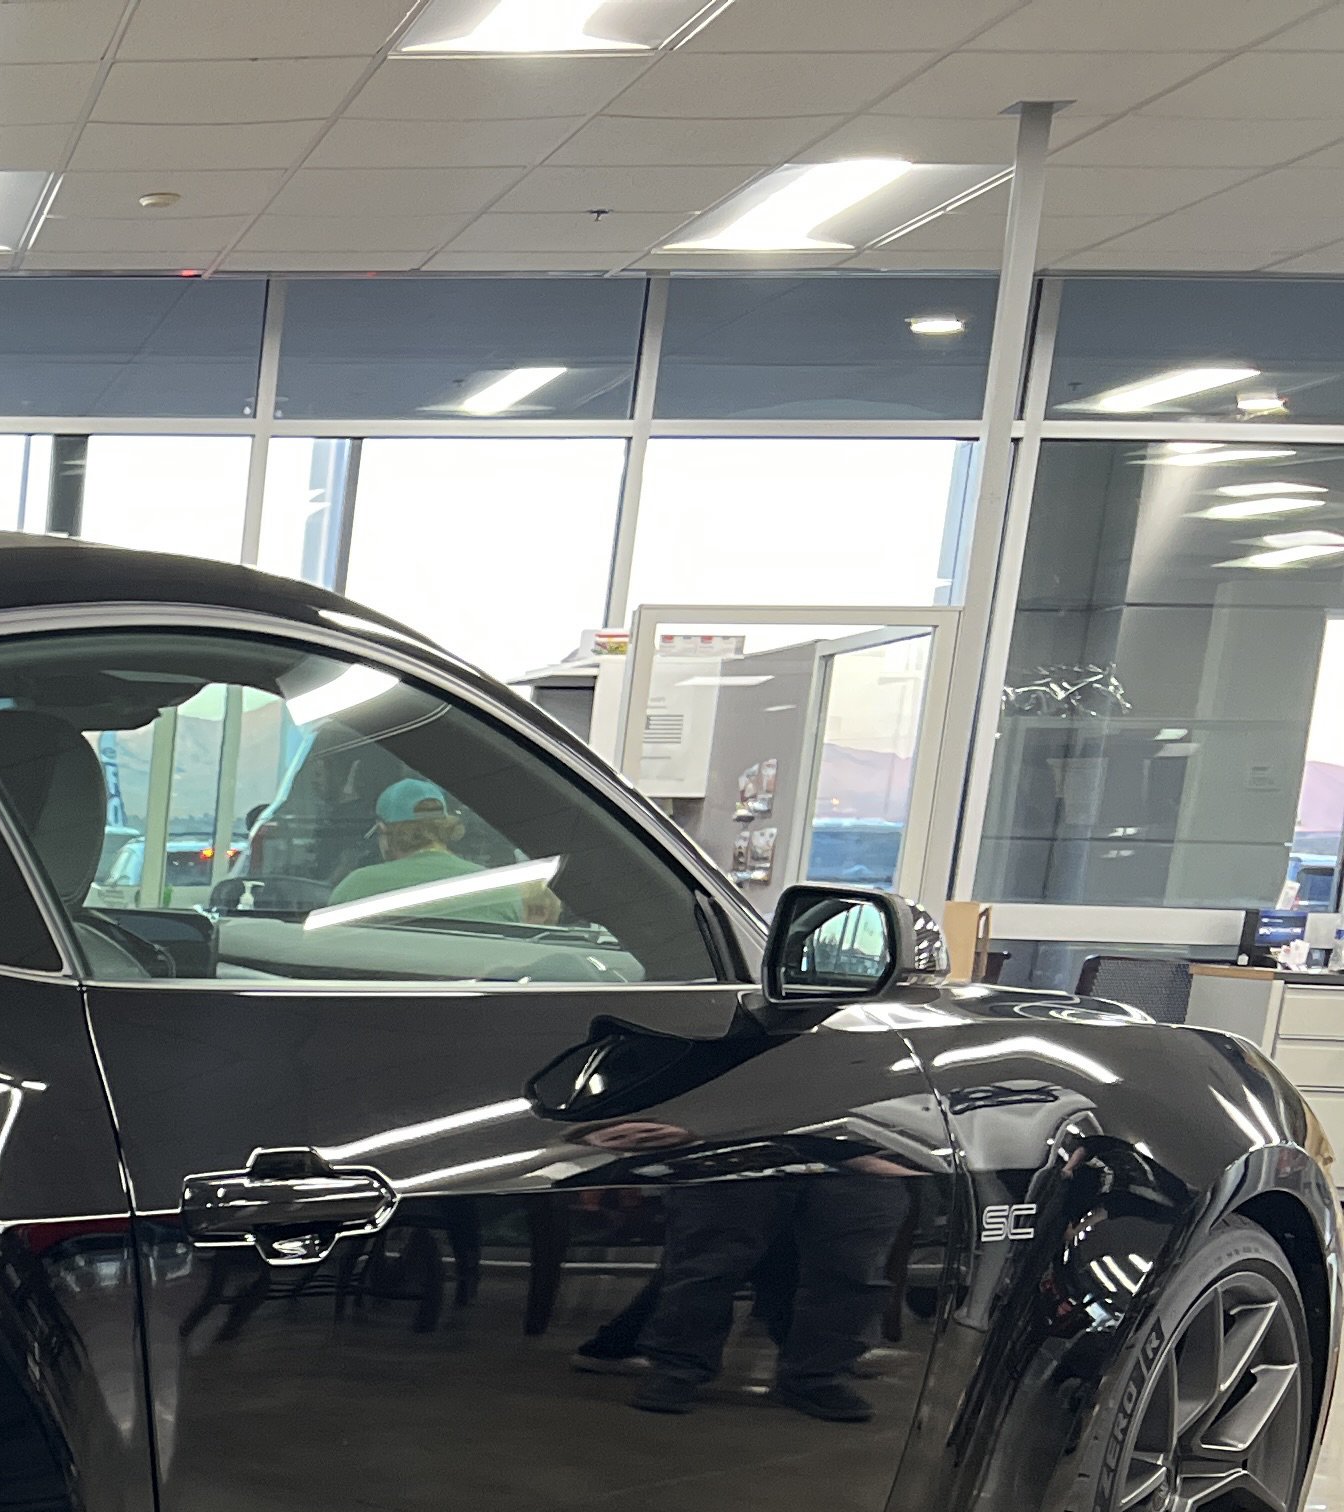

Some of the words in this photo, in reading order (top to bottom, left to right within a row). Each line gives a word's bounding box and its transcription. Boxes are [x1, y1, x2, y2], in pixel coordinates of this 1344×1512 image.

[981, 1203, 1037, 1242] SC
[1100, 1380, 1137, 1499] ZERO
[1145, 1331, 1161, 1360] R
